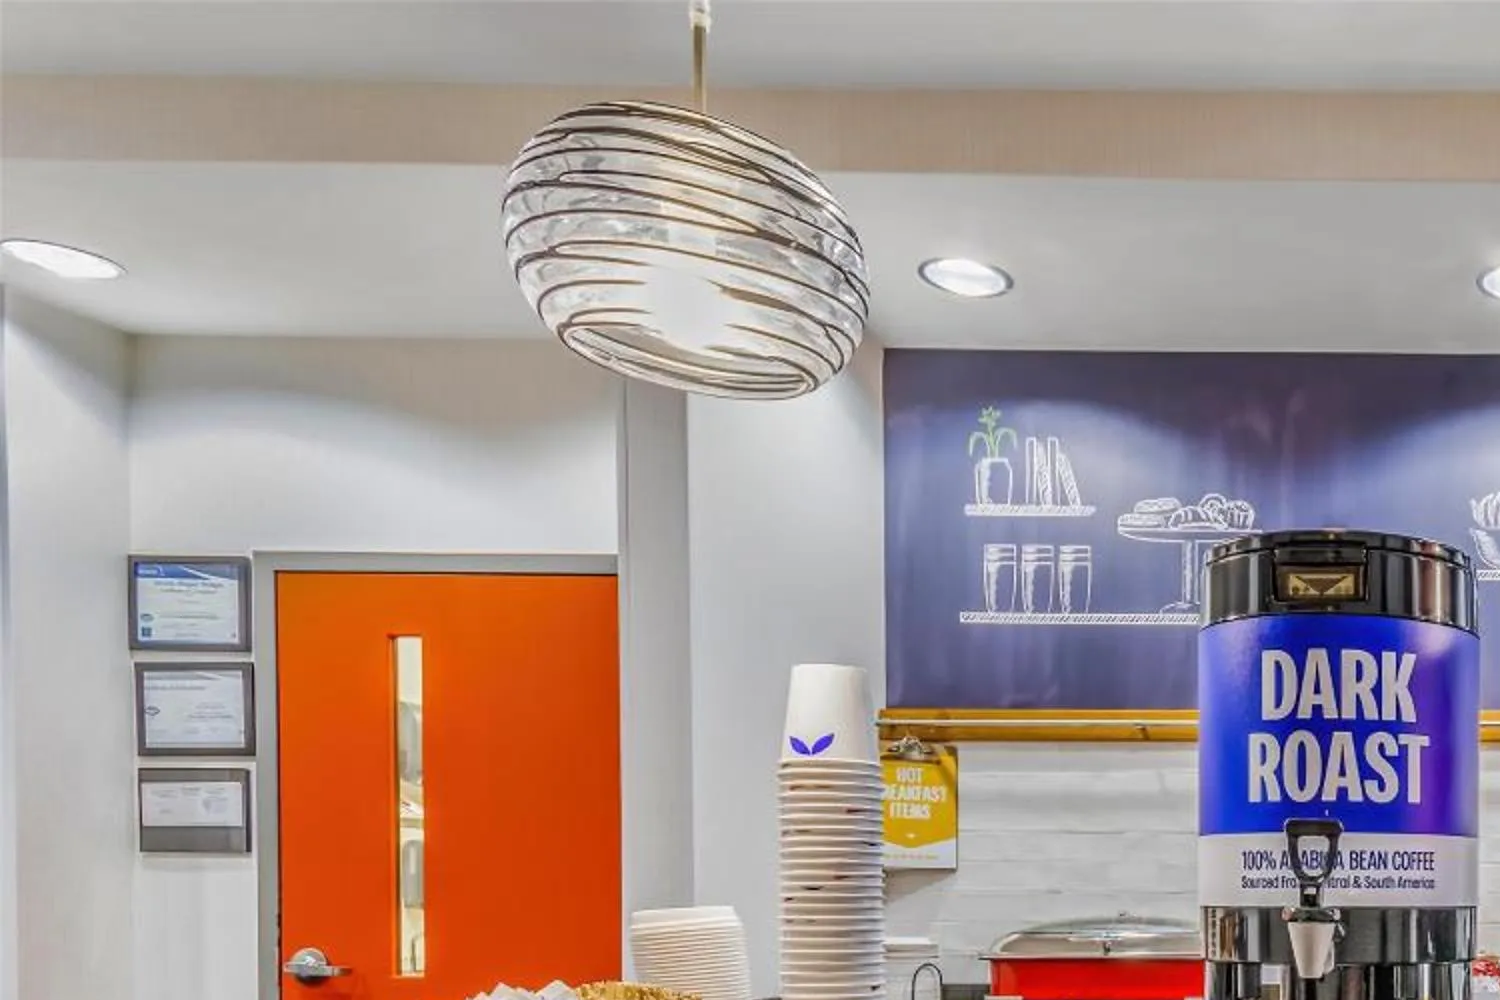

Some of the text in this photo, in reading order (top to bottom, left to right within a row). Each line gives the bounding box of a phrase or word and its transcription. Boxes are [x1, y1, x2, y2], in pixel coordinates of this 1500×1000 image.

[1261, 648, 1417, 723] DARK
[1247, 729, 1431, 804] ROAST
[880, 783, 947, 802] REAKFAST
[1241, 850, 1277, 870] 100%
[1349, 850, 1388, 870] BEAN
[1391, 851, 1435, 871] COFFEE
[1281, 875, 1298, 889] Fro
[1352, 876, 1361, 889] &
[1363, 875, 1396, 889] South
[1398, 876, 1435, 889] America
